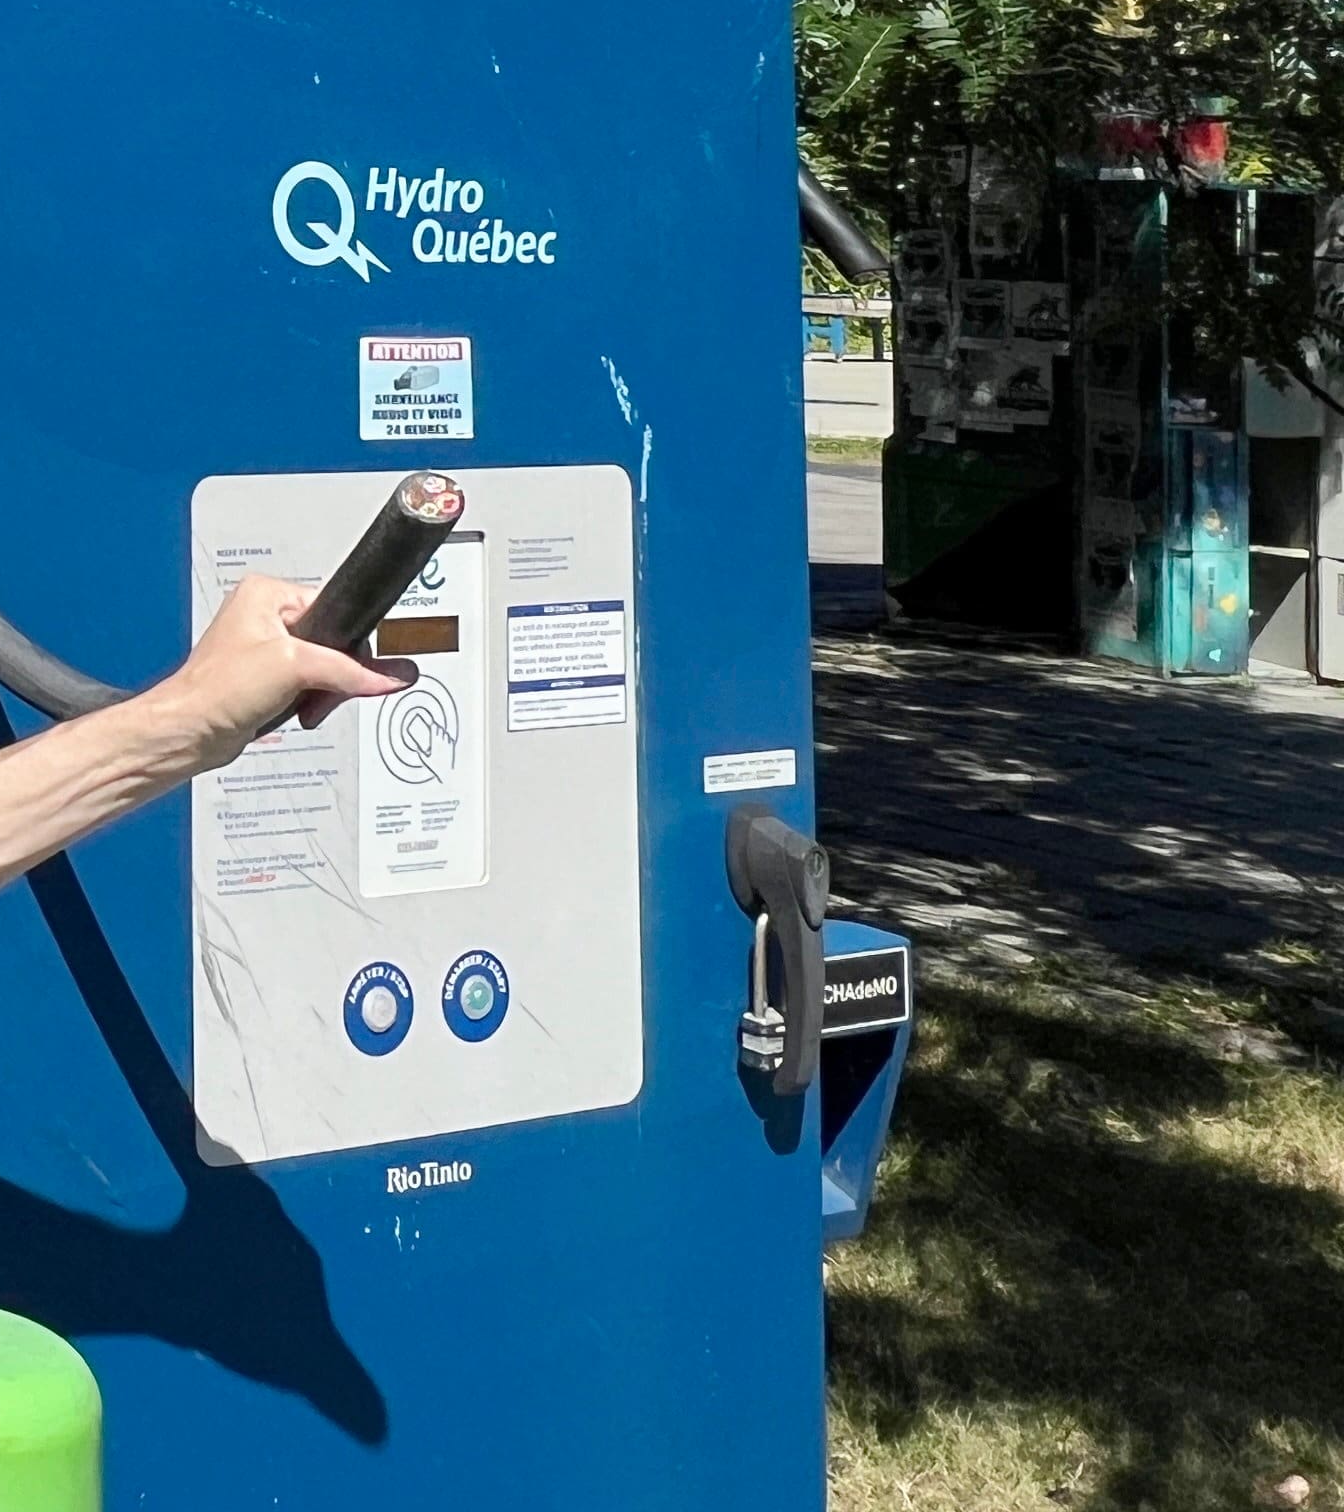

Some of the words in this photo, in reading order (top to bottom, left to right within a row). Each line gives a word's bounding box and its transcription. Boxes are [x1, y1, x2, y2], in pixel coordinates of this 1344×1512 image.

[365, 167, 485, 219] Hydro
[411, 218, 558, 265] Québec
[372, 343, 461, 360] ATTENTION
[375, 394, 459, 405] SURVEILLANCE
[823, 975, 898, 1004] CHAdeMO
